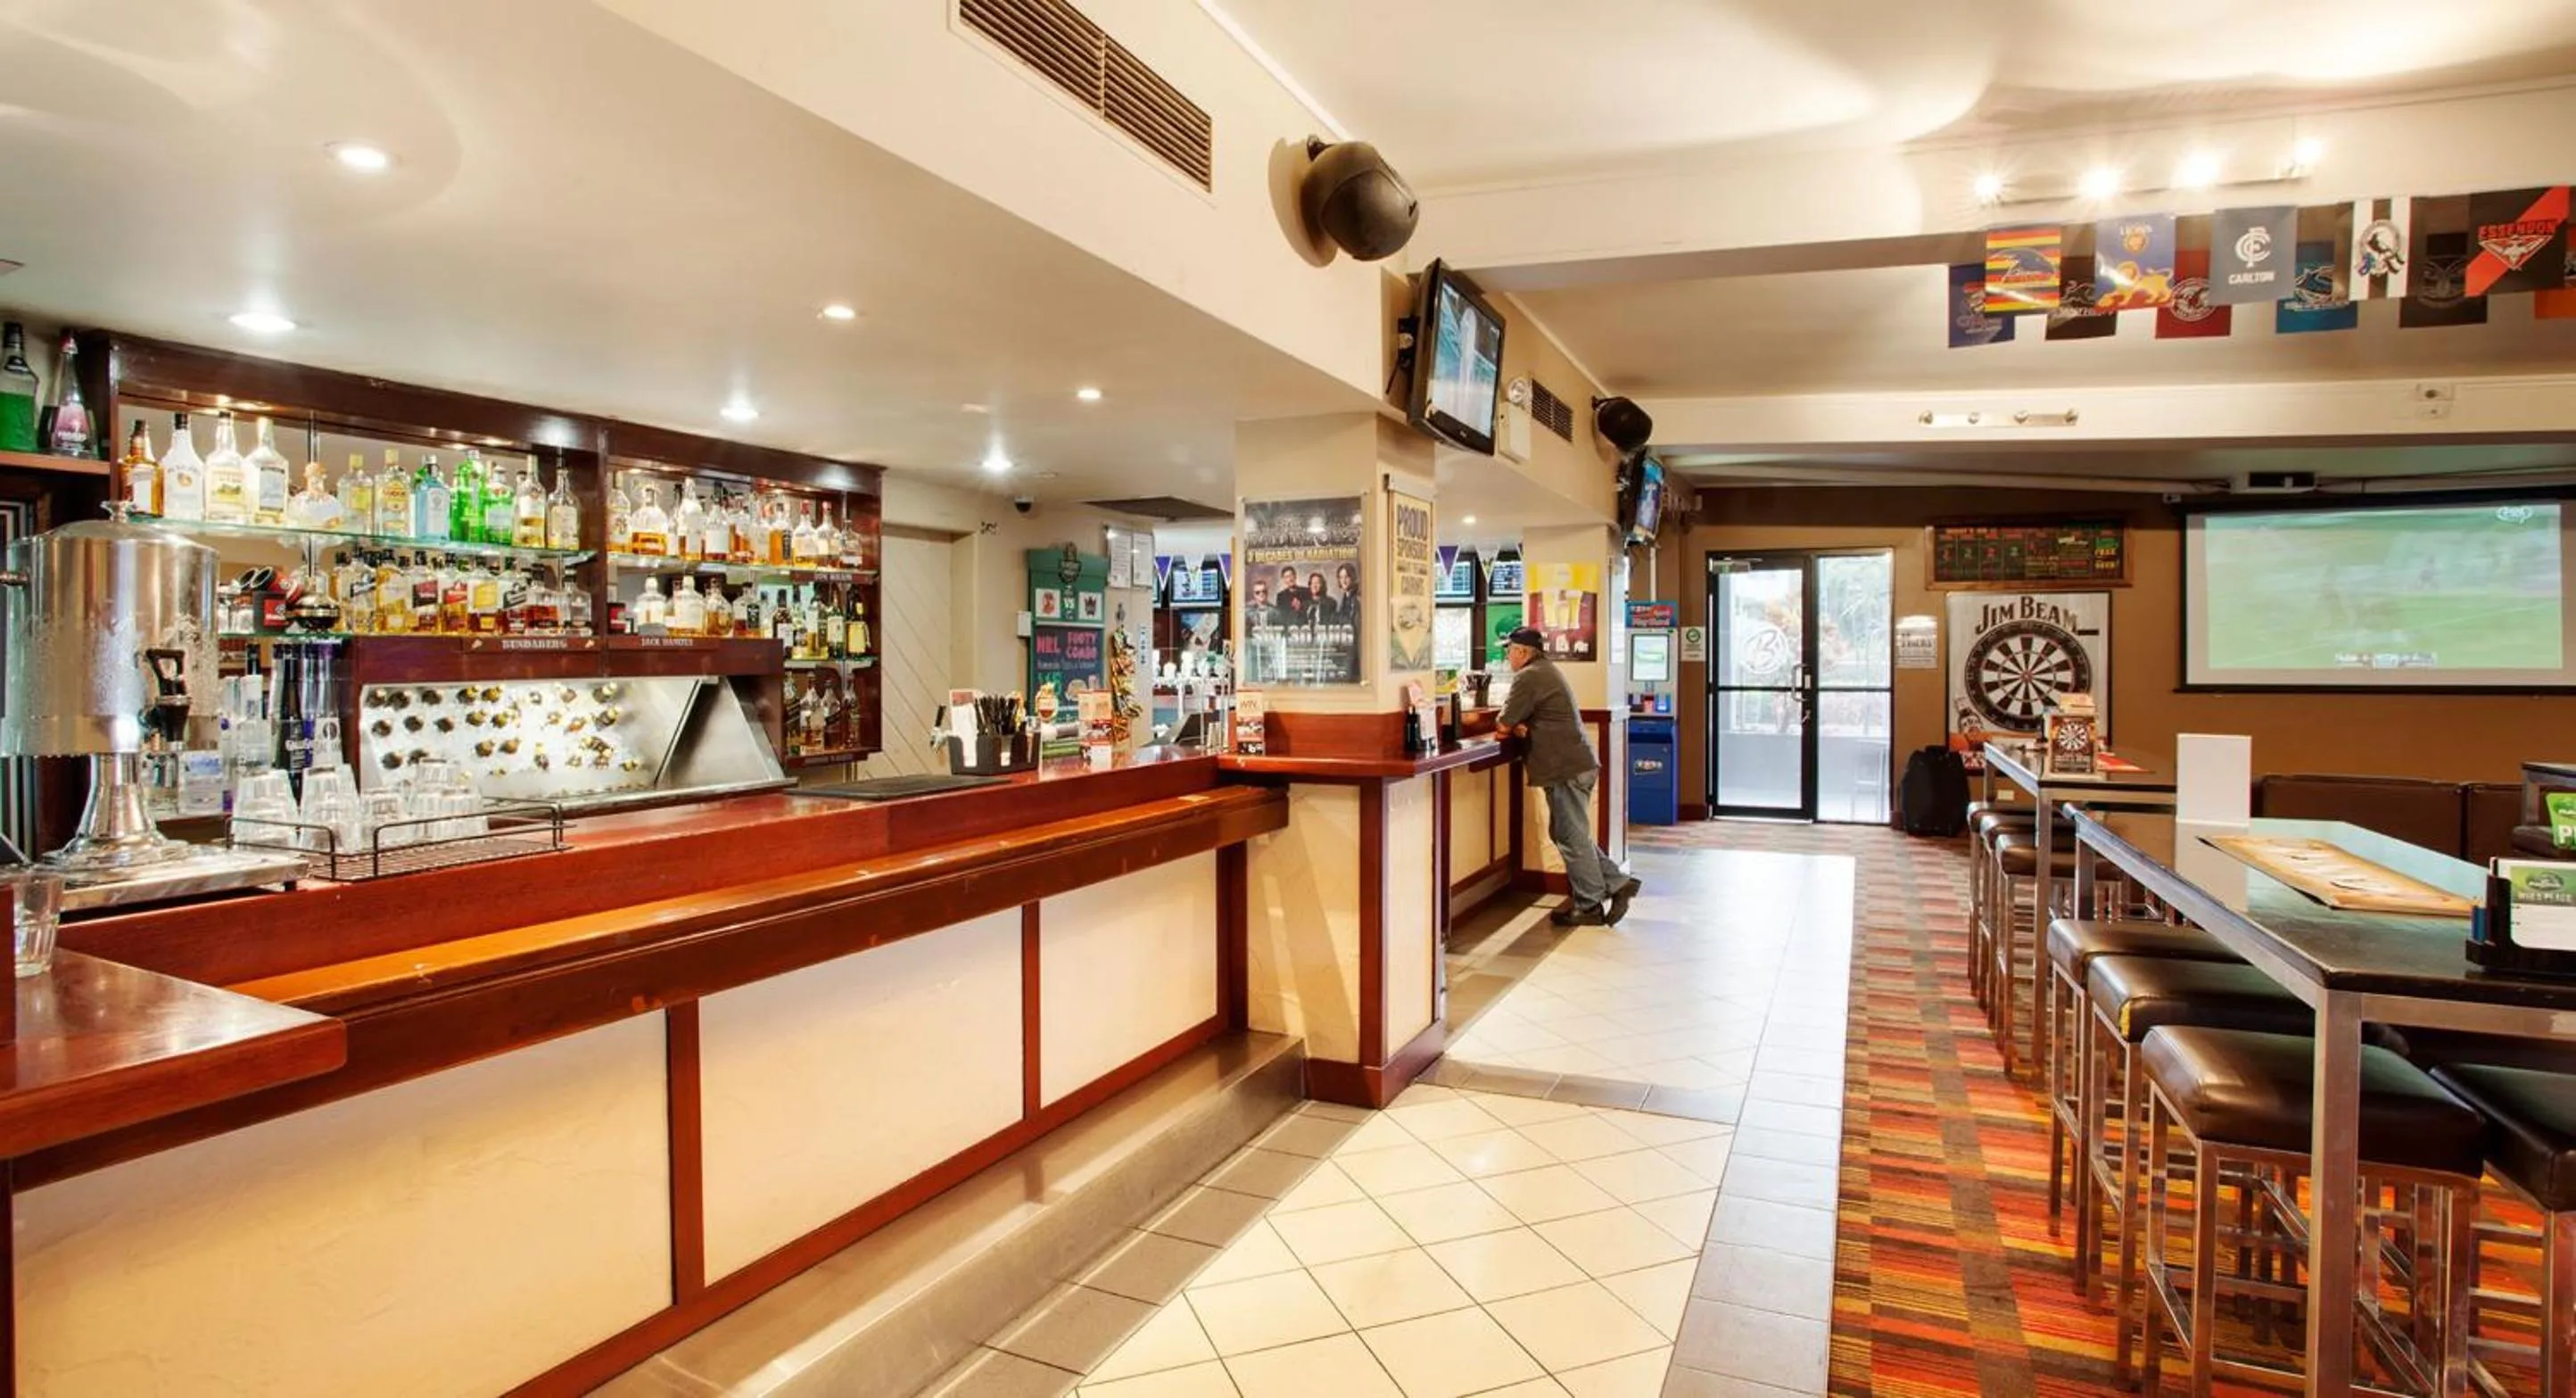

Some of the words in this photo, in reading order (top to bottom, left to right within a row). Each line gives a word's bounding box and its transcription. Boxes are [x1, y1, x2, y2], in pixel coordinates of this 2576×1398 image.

[2478, 219, 2558, 240] ESSENDON
[2228, 271, 2275, 285] CARLTON
[1396, 504, 1428, 541] PROUD
[1975, 603, 2016, 635] JIM
[2019, 596, 2079, 633] BEAM
[501, 639, 568, 649] BUNDABERG
[1036, 633, 1061, 654] NRL
[1067, 632, 1098, 644] FOOTY
